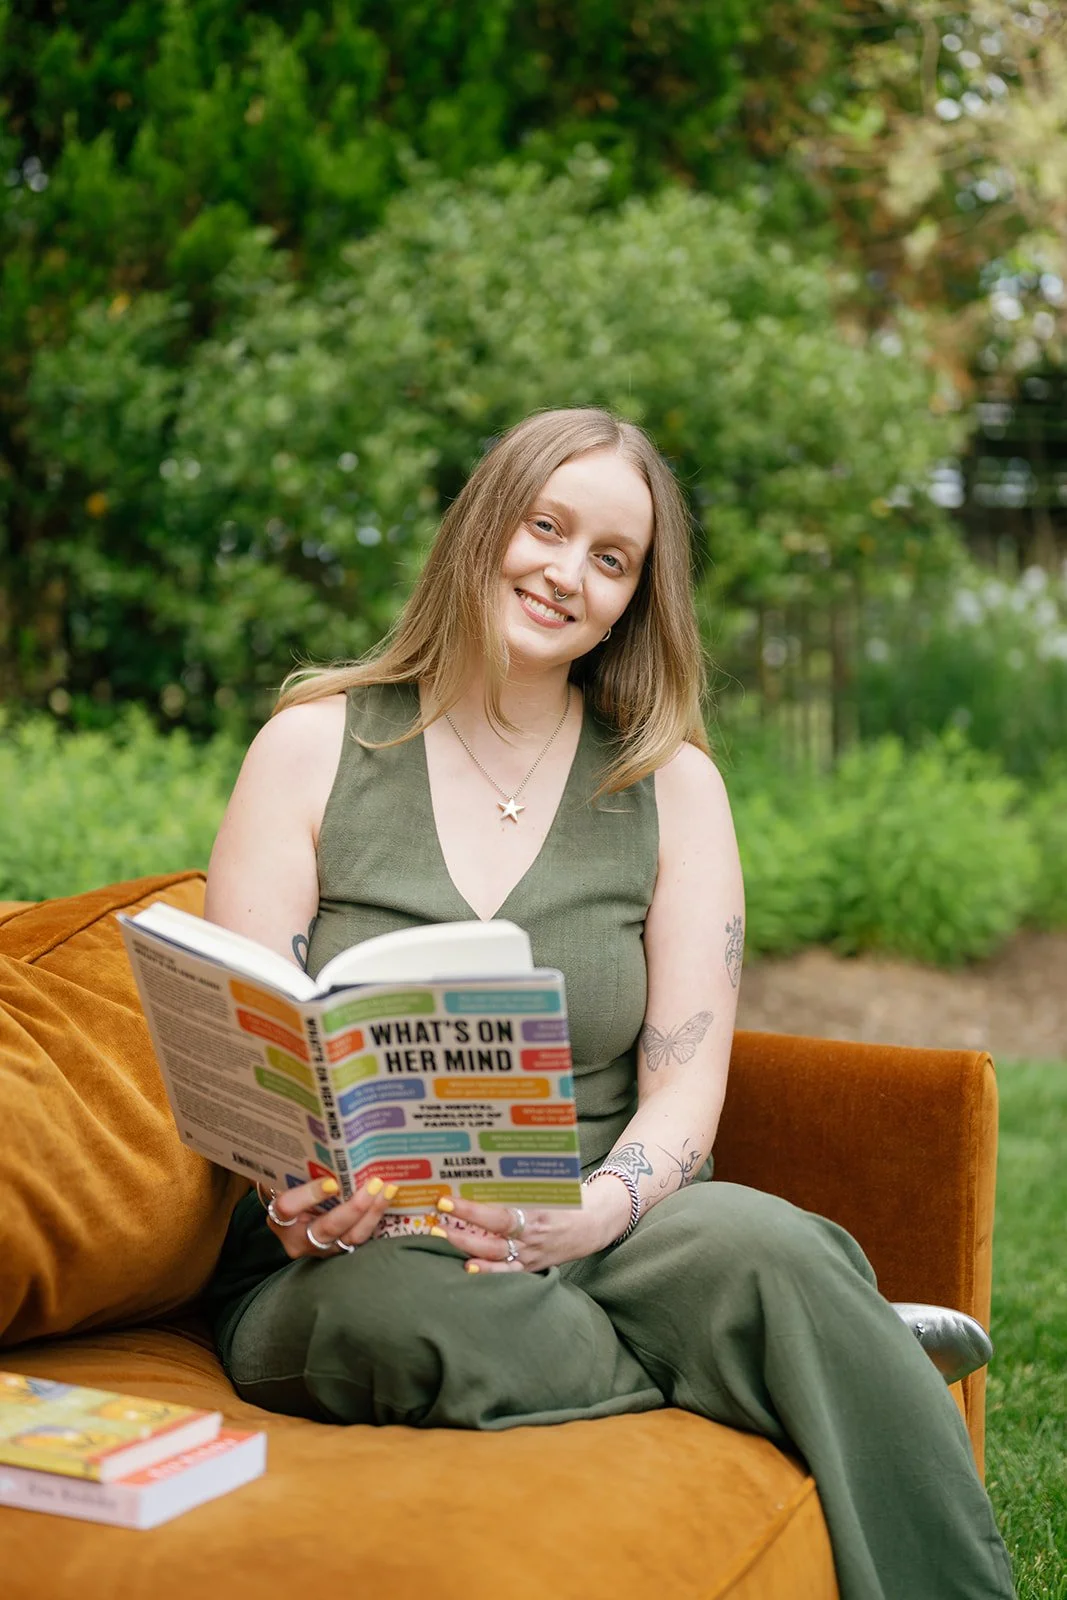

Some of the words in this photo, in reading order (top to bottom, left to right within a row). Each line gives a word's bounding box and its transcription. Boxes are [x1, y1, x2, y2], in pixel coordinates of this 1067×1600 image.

[369, 1018, 470, 1047] WHAT'S
[478, 1019, 514, 1043] ON
[386, 1050, 438, 1074] HER
[445, 1049, 513, 1072] MIND
[419, 1103, 442, 1111] THE
[445, 1103, 493, 1111] MENTAL
[412, 1112, 485, 1120] WORKLOAD
[443, 1156, 487, 1167] ALLISON
[439, 1168, 495, 1180] DAMINGER
